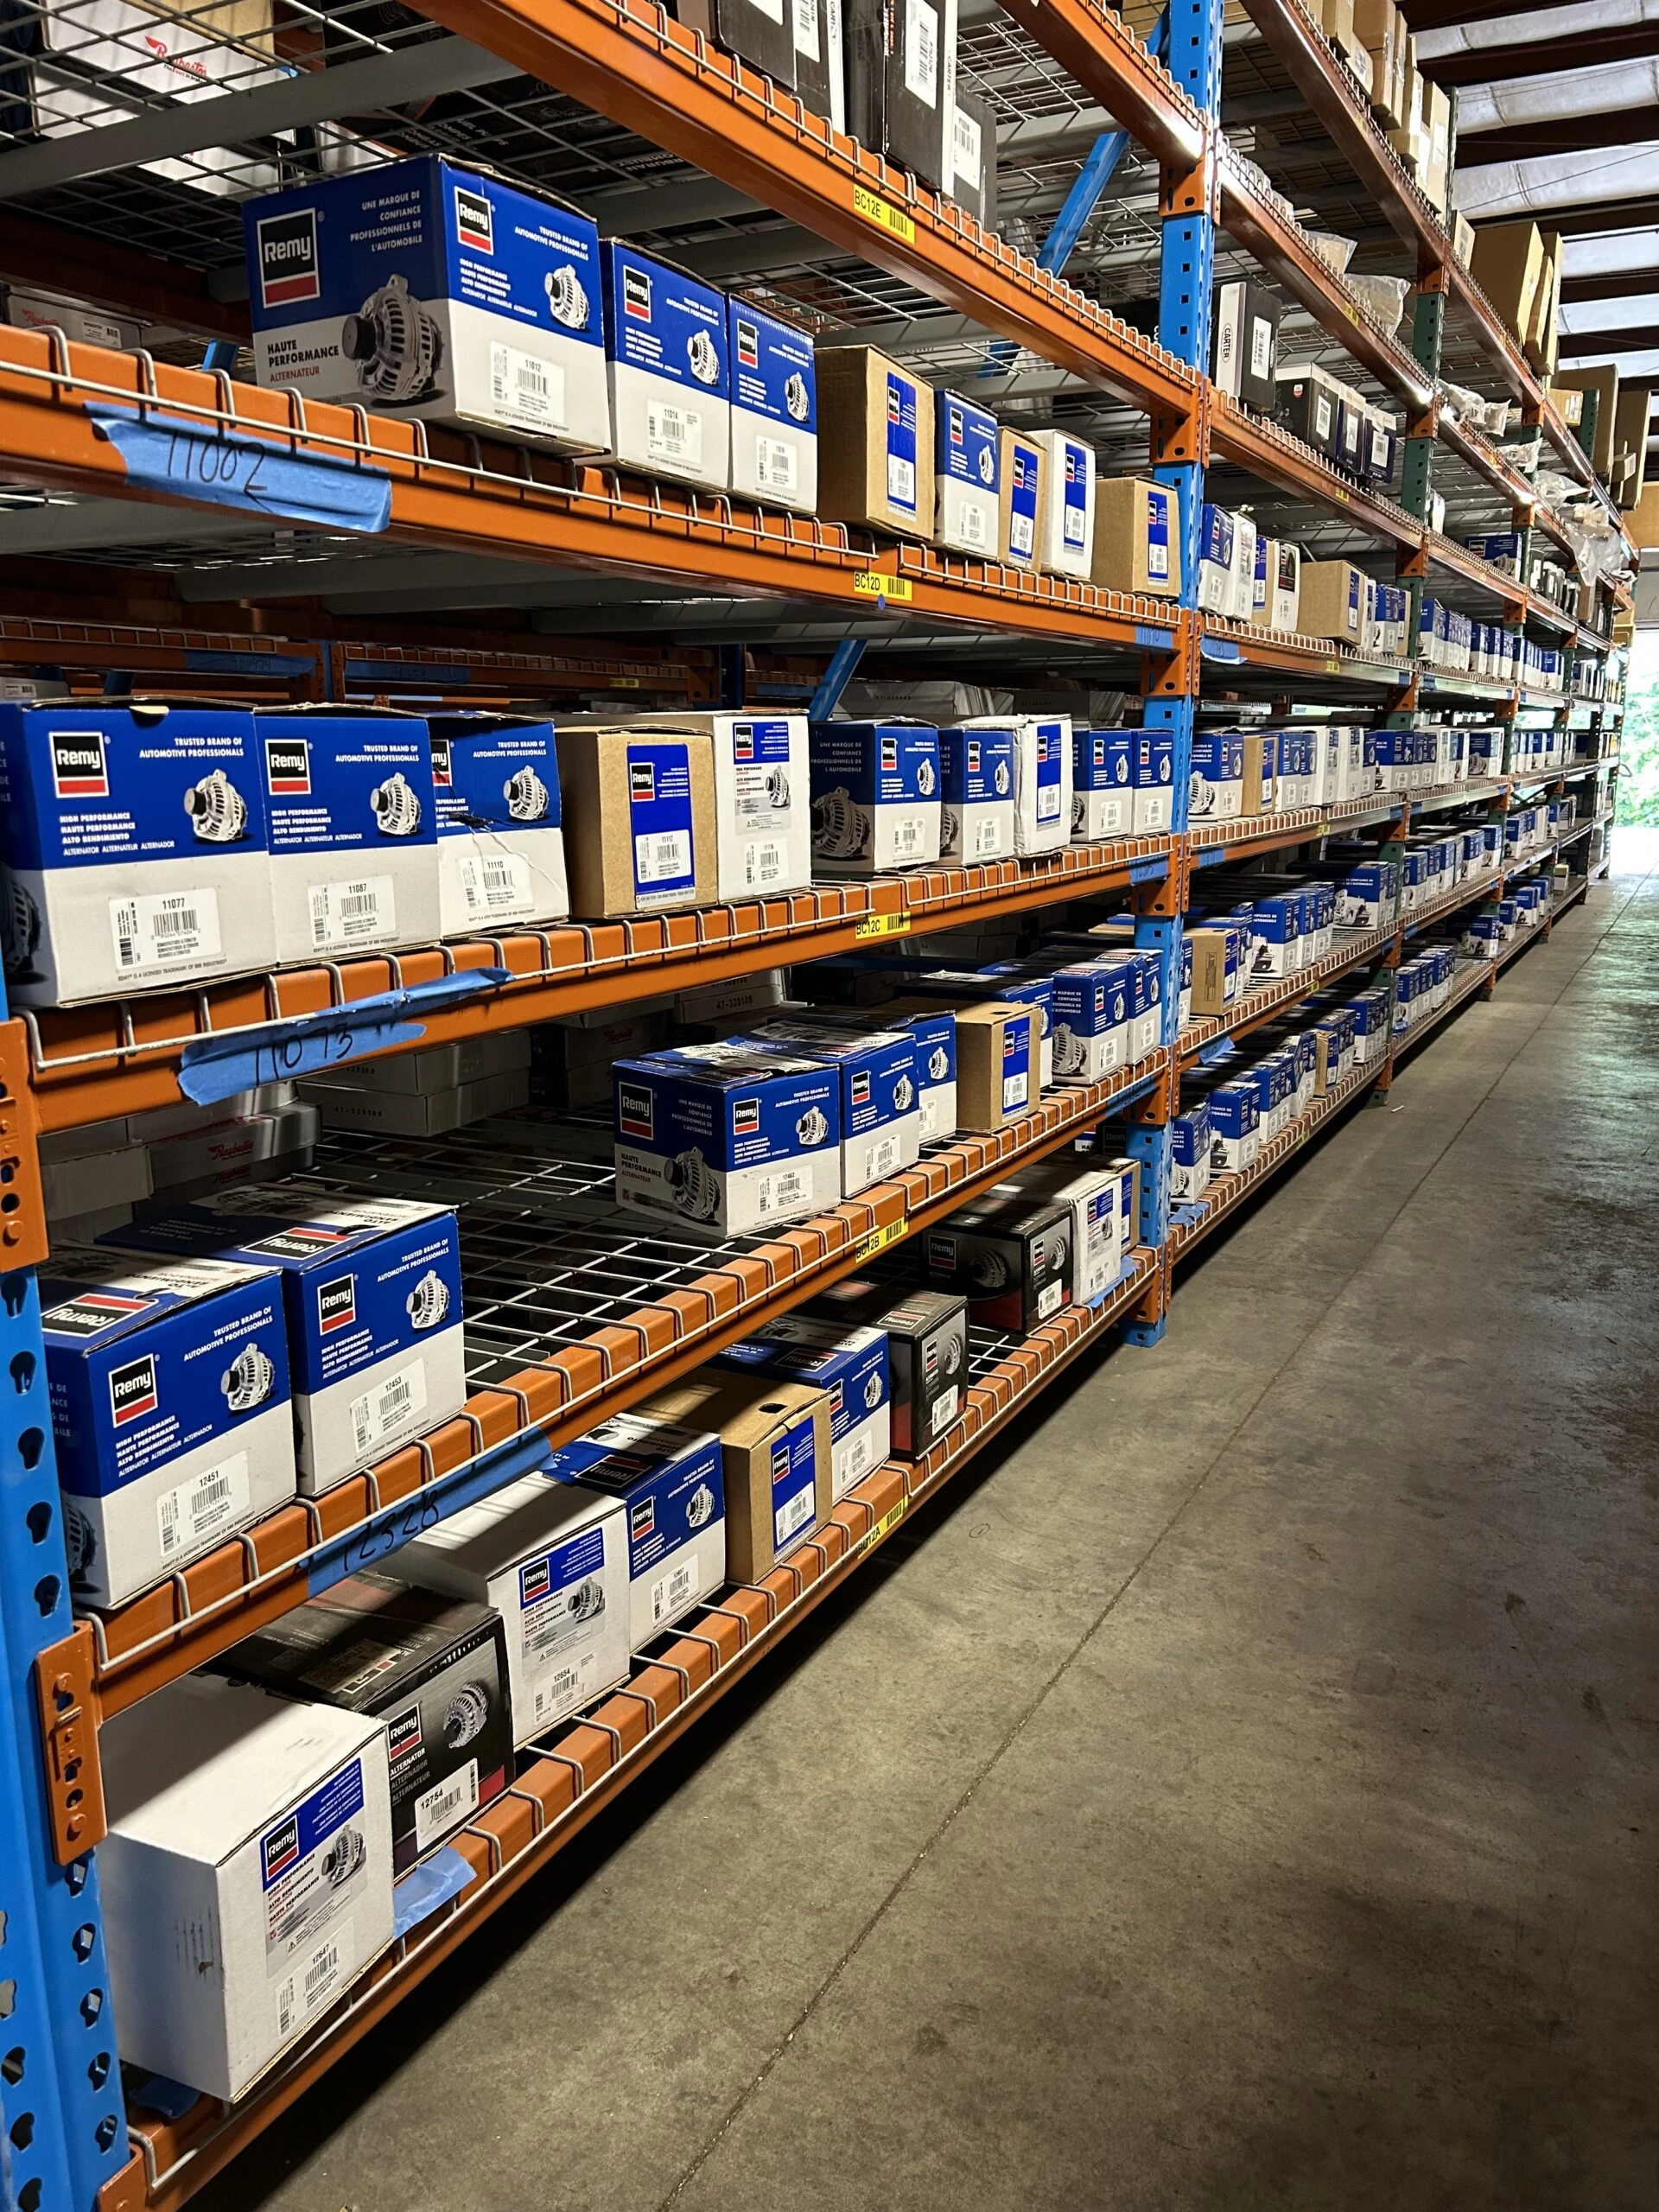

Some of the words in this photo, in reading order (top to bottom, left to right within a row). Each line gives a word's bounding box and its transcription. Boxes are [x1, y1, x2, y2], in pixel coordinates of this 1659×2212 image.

[362, 199, 377, 211] UNE
[378, 193, 409, 207] MARQUE
[410, 190, 420, 200] DE
[854, 188, 881, 219] BC12E
[380, 205, 421, 221] CONFIANCE
[459, 205, 488, 231] Remy
[350, 222, 410, 242] PROFESSIONNELS
[412, 220, 422, 229] DE
[539, 226, 560, 242] TRUSTED
[561, 233, 580, 249] BRAND
[580, 241, 588, 251] OF
[264, 234, 311, 264] Remy
[372, 234, 423, 252] L'AUTOMOBILE
[514, 226, 546, 246] AUTOMOTIVE
[547, 237, 588, 261] PROFESSIONALS
[626, 278, 648, 302] Remy
[267, 339, 297, 354] HAUTE
[269, 346, 339, 367] PERFORMANCE
[270, 366, 321, 383] ALTERNATEUR
[525, 359, 542, 372] 11012
[664, 408, 677, 419] 11014
[167, 430, 268, 485] 11002
[855, 573, 880, 591] BC12D
[736, 734, 752, 744] Remy
[57, 749, 100, 769] Remy
[139, 748, 187, 758] AUTOMOTIVE
[188, 748, 244, 757] PROFESSIONALS
[271, 754, 305, 772] Remy
[335, 754, 373, 763] AUTOMOTIVE
[432, 752, 447, 766] my
[632, 772, 652, 785] Remy
[80, 812, 130, 822] PERFORMANCE
[60, 825, 85, 834] HAUTE
[86, 823, 136, 832] PERFORMANCE
[63, 836, 80, 844] ALTO
[82, 833, 130, 842] RENDIMIENTO
[64, 846, 99, 855] ALTERNATOR
[102, 844, 138, 853] ALTERNATEUR
[141, 841, 175, 849] ALTERNADOR
[348, 883, 367, 893] 11087
[162, 898, 185, 910] 11077
[856, 919, 880, 936] BC12C
[257, 1024, 353, 1089] 11073
[623, 1096, 650, 1116] Remy
[735, 1108, 756, 1119] Remy
[621, 1154, 639, 1163] HAUTE
[621, 1160, 662, 1178] PERFORMANCE
[265, 1237, 324, 1253] Remy
[401, 1249, 423, 1263] TRUSTED
[423, 1243, 441, 1255] BRAND
[441, 1238, 449, 1248] OF
[855, 1236, 880, 1259] BC12B
[377, 1262, 410, 1282] AUTOMOTIVE
[410, 1247, 450, 1269] PROFESSIONALS
[321, 1288, 352, 1310] Remy
[45, 1308, 116, 1327] Remy
[213, 1319, 239, 1338] TRUSTED
[240, 1311, 262, 1327] BRAND
[263, 1306, 272, 1316] OF
[183, 1337, 224, 1362] AUTOMOTIVE
[225, 1315, 273, 1342] PROFESSIONALS
[321, 1344, 334, 1355] HIGH
[335, 1328, 370, 1349] PERFORMANCE
[322, 1350, 338, 1362] HAUTE
[338, 1335, 372, 1357] PERFORMANCE
[375, 1339, 399, 1355] ALTERNADOR
[322, 1359, 335, 1370] ALTO
[336, 1344, 369, 1363] RENDIMIENTO
[114, 1371, 151, 1398] Remy
[385, 1376, 402, 1392] 12453
[116, 1436, 131, 1449] HIGH
[132, 1415, 175, 1440] PERFORMANCE
[117, 1443, 137, 1458] HAUTE
[137, 1422, 180, 1448] PERFORMANCE
[118, 1454, 134, 1467] ALTO
[134, 1433, 175, 1459] RENDIMIENTO
[118, 1458, 149, 1478] ALTERNATOR
[151, 1440, 181, 1460] ALTERNATEUR
[183, 1424, 213, 1444] ALTERNADOR
[200, 1470, 219, 1487] 12451
[633, 1507, 652, 1526] Remy
[525, 1568, 547, 1586] Remy
[538, 1610, 567, 1629] PERFORMANCE
[391, 1715, 417, 1740] Remy
[390, 1747, 425, 1778] ALTERNATOR
[391, 1759, 428, 1790] ALTERNADOR
[391, 1771, 430, 1803] ALTERNATEUR
[420, 1788, 443, 1810] 12754
[269, 1828, 296, 1858] Remy
[268, 1885, 281, 1897] HIGH
[282, 1853, 315, 1885] PERFORMANCE
[269, 1897, 281, 1909] ALTO
[282, 1867, 314, 1897] RENDIMIENTO
[270, 1908, 285, 1923] HAUTE
[286, 1876, 321, 1907] PERFORMANCE
[312, 1944, 330, 1964] 12647
